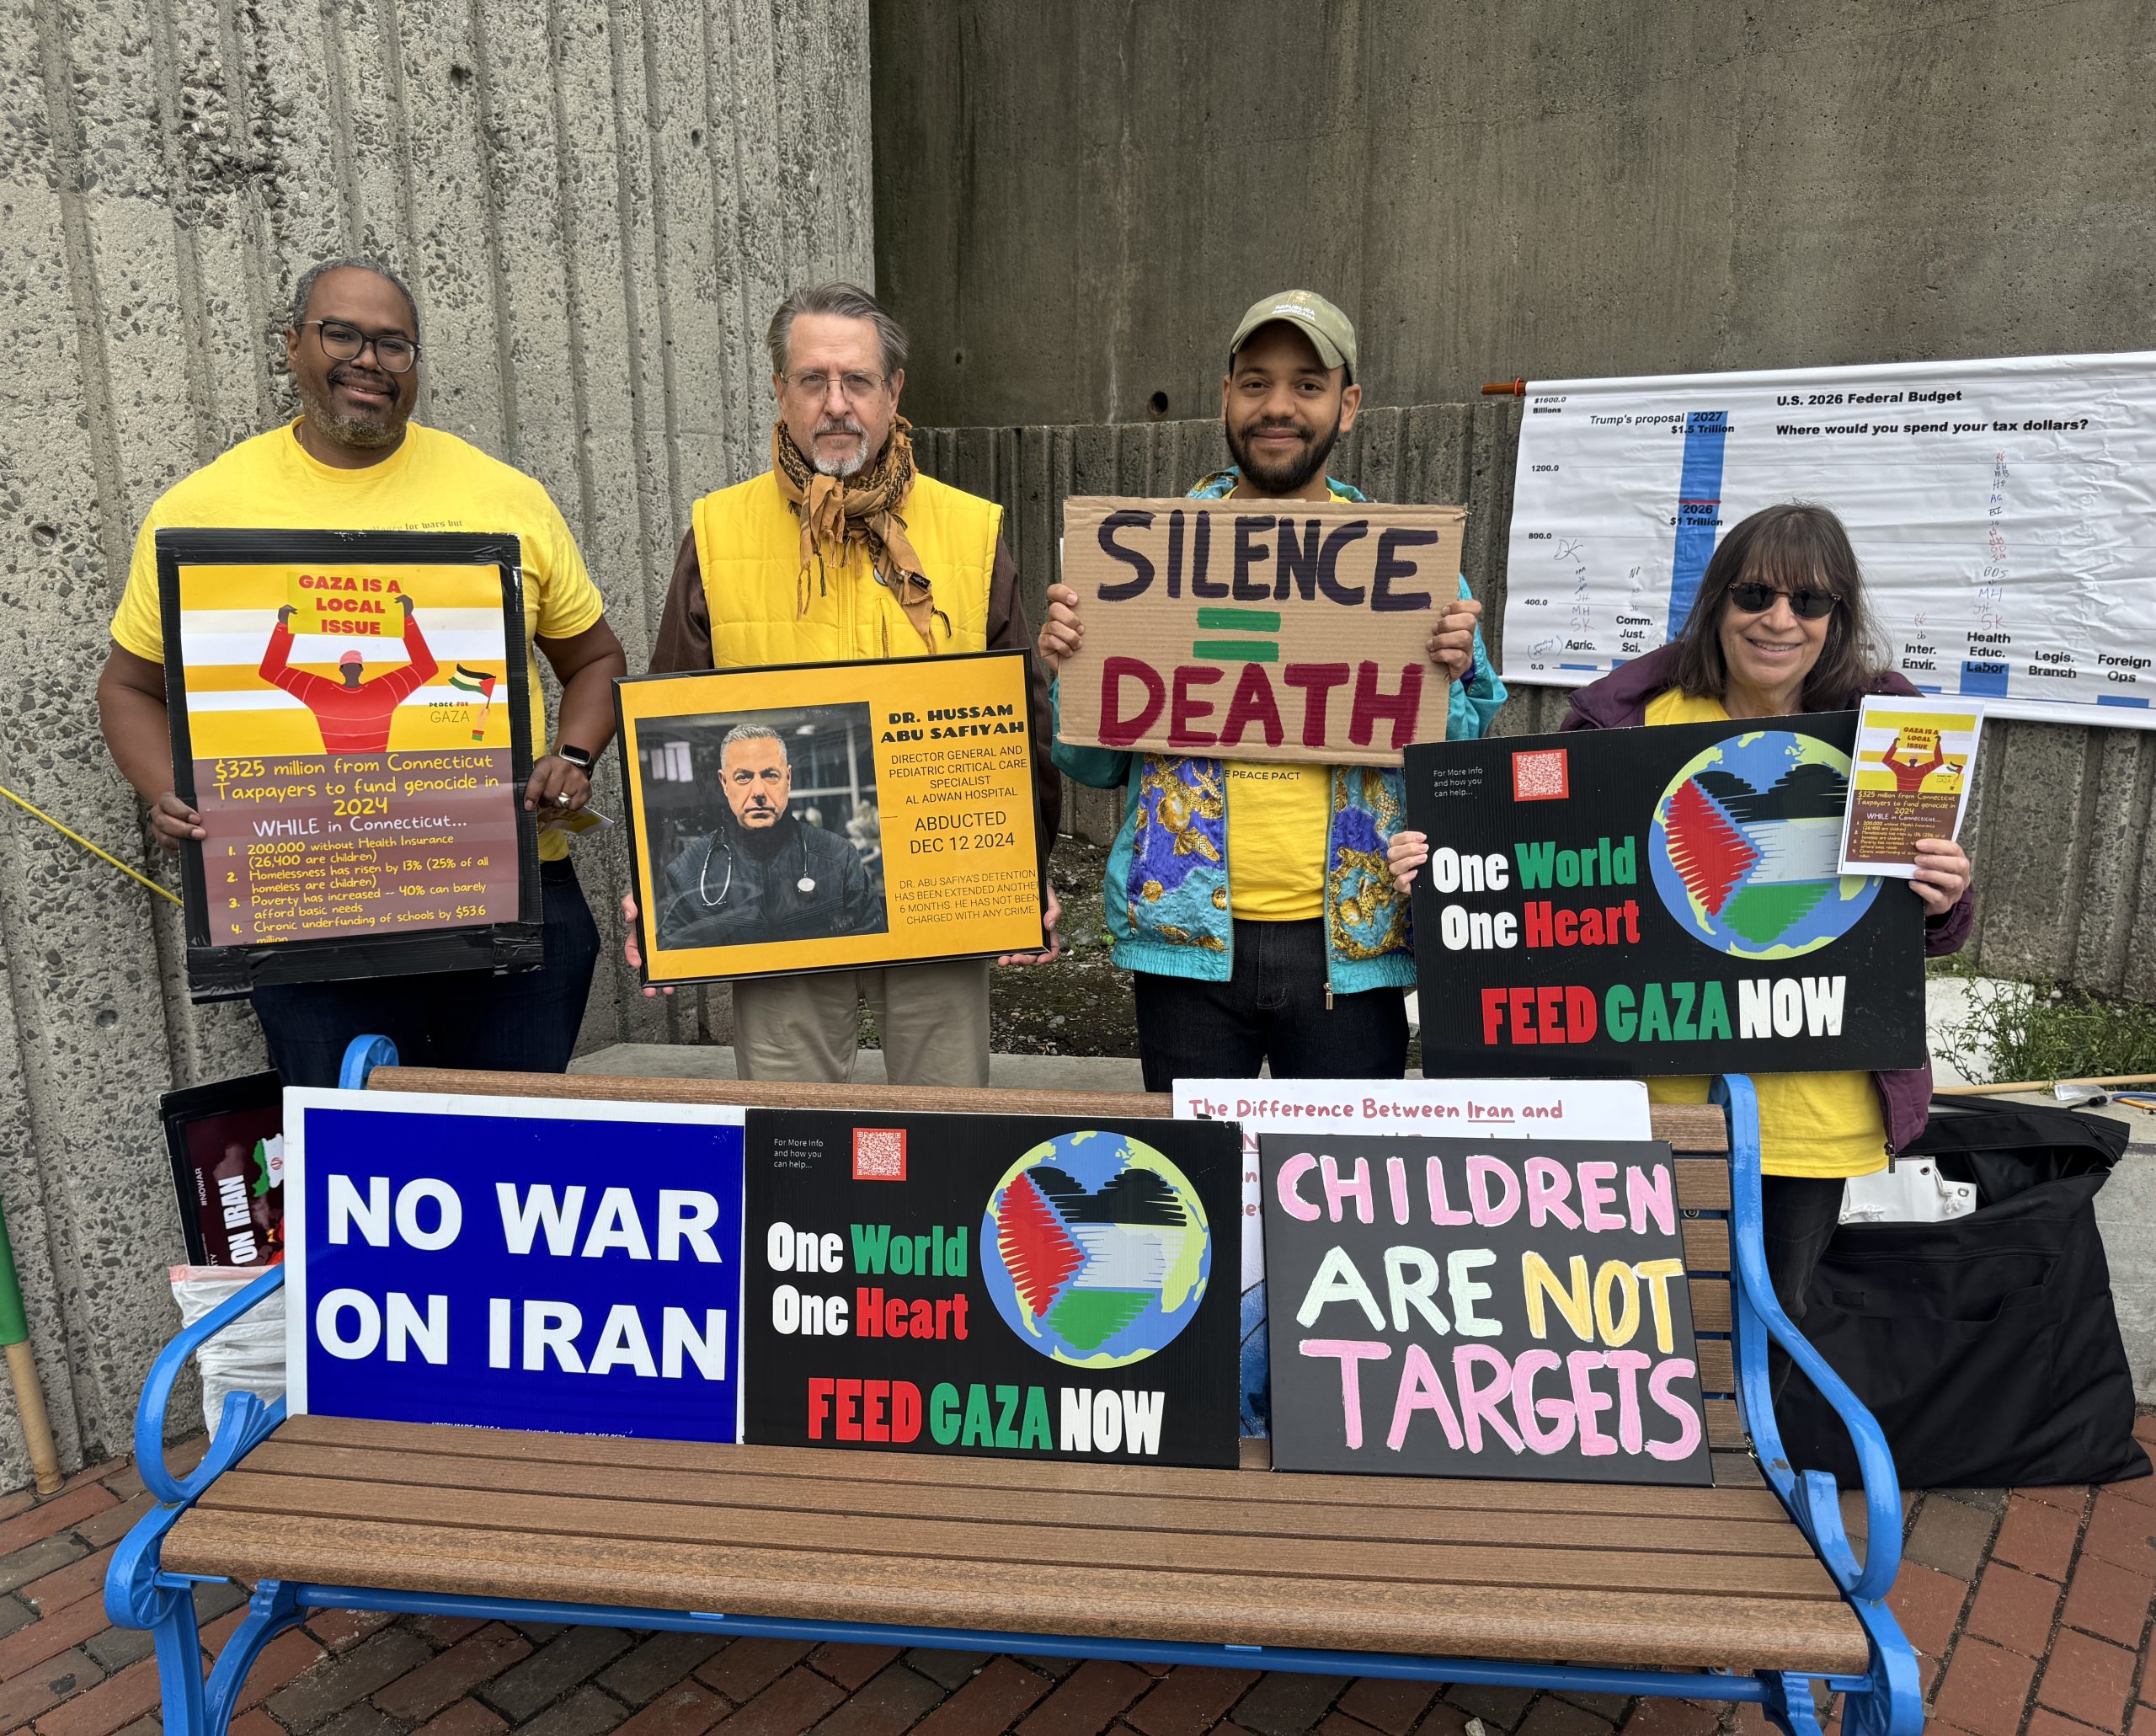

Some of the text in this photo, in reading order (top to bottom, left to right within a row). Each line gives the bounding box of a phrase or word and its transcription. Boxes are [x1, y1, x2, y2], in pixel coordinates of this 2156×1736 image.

[1776, 391, 1962, 406] U.S. 2026 Federal Budget
[1590, 413, 1684, 425] Trump's proposal
[1693, 412, 1722, 422] 2027
[1671, 425, 1734, 434] $1.5 Trillion
[1776, 419, 2089, 435] Where would you spend your tax dollars?
[1684, 505, 1713, 514] 2026
[1670, 517, 1682, 526] $1
[1097, 509, 1439, 612] SILENCE
[299, 574, 401, 594] GAZA IS A
[316, 597, 385, 614] LOCAL
[322, 619, 381, 635] ISSUE
[1616, 616, 1653, 626] Comm.
[1620, 630, 1645, 638] Just.
[1967, 632, 2011, 644] Health
[1565, 640, 1597, 650] Agric.
[1620, 643, 1641, 653] Sci.
[1905, 644, 1937, 654] Inter.
[1970, 647, 2005, 658] Educ.
[1902, 659, 1937, 670] Envir.
[2035, 651, 2074, 664] Legis.
[2098, 654, 2151, 669] Foreign
[1967, 661, 2004, 673] Labor
[2028, 665, 2077, 678] Branch
[2107, 670, 2137, 683] Ops
[1098, 655, 1425, 749] DEATH
[430, 710, 469, 723] GAZA
[889, 704, 1013, 724] DR. HUSSAM
[881, 722, 1024, 744] ABU SAFIYAH
[891, 745, 1022, 764] DIRECTOR GENERAL AND
[215, 755, 494, 782] $325 million from Connecticut
[889, 759, 1027, 778] PEDIATRIC CRITICAL CARE
[1233, 771, 1268, 780] PEACE
[213, 773, 499, 803] Taxpayers to fund genocide in
[930, 776, 990, 788] SPECIALIST
[905, 788, 1017, 804] AL ADWAN HOSPITAL
[1918, 793, 1955, 801] Connecticut
[333, 797, 388, 816] 2024
[253, 815, 467, 837] WHILE in Connecticut...
[915, 811, 1006, 831] ABDUCTED
[228, 835, 454, 857] 1. 200,000 without Health Insurance
[910, 832, 1015, 854] DEC 12 2024
[249, 849, 377, 869] (26,400 are children)
[1433, 836, 1637, 894] One World
[899, 869, 1036, 889] DR. ABU SAFIYA'S DETENTION
[895, 892, 915, 901] HAS
[917, 890, 942, 900] BEEN
[945, 885, 994, 897] EXTENDED
[955, 900, 968, 908] HE
[971, 898, 990, 907] HAS
[993, 895, 1011, 905] NOT
[1015, 894, 1039, 903] BEEN
[907, 913, 953, 925] CHARGED
[955, 911, 979, 920] WITH
[983, 909, 1001, 918] ANY
[1441, 900, 1641, 951] One Heart
[1481, 975, 1846, 1044] FEED GAZA NOW
[1189, 1098, 1563, 1119] The Difference Between Iran and
[789, 1161, 812, 1169] help...
[195, 1167, 207, 1206] #NOWAR
[1277, 1152, 1675, 1236] CHILDREN
[218, 1174, 258, 1263] ON IRAN
[328, 1173, 723, 1263] NO WAR
[767, 1221, 968, 1277] One World
[1296, 1246, 1684, 1354] ARE NOT
[771, 1285, 969, 1341] One Heart
[315, 1288, 727, 1381] ON IRAN
[1299, 1338, 1701, 1461] TARGETS
[808, 1377, 1165, 1455] FEED GAZA NOW
